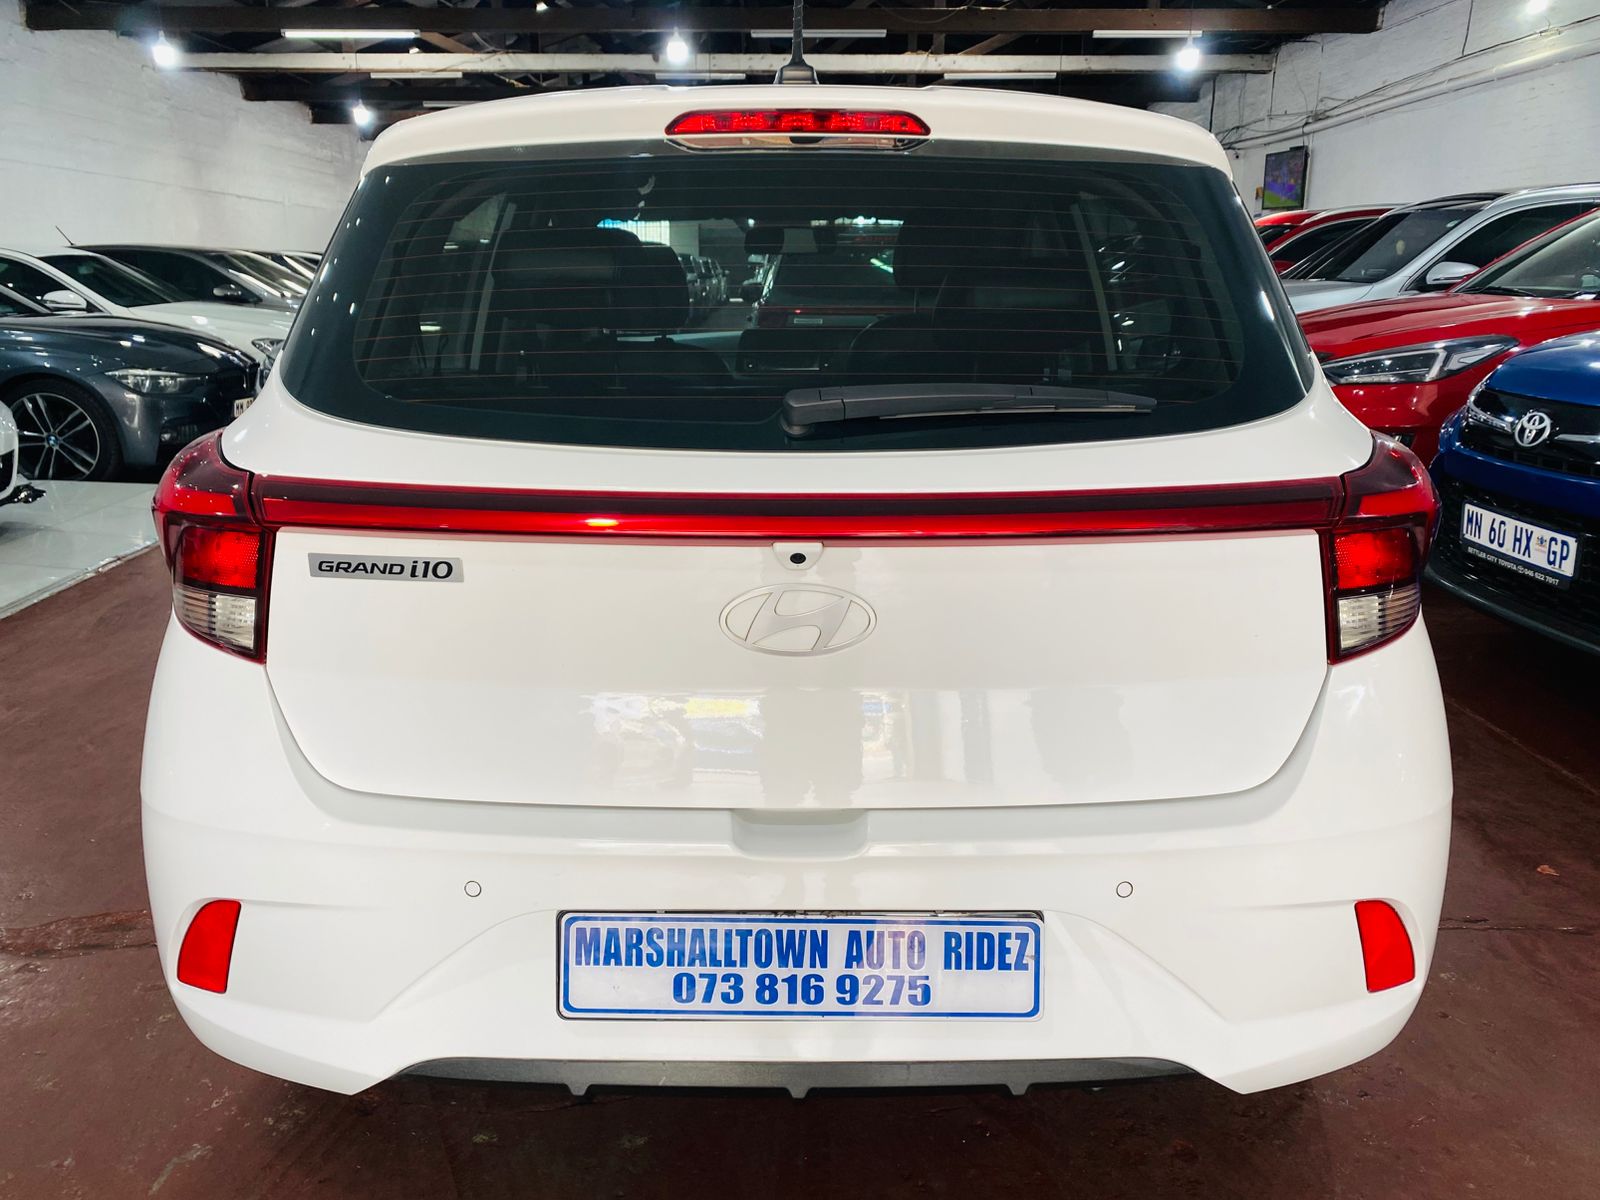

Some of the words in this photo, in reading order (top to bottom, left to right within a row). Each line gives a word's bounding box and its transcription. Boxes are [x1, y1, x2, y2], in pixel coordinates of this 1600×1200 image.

[1488, 517, 1507, 548] 60
[1511, 524, 1534, 559] HX
[1546, 536, 1570, 569] GP
[317, 560, 405, 576] GRAND
[409, 560, 453, 579] i10
[1498, 558, 1517, 571] TOYOTA
[574, 927, 829, 970] MARSHALLTOWN
[844, 929, 927, 971] AUTO
[943, 930, 1030, 972] RIDEZ
[671, 971, 745, 1005] 073
[754, 972, 826, 1006] 816
[835, 973, 933, 1007] 9275
